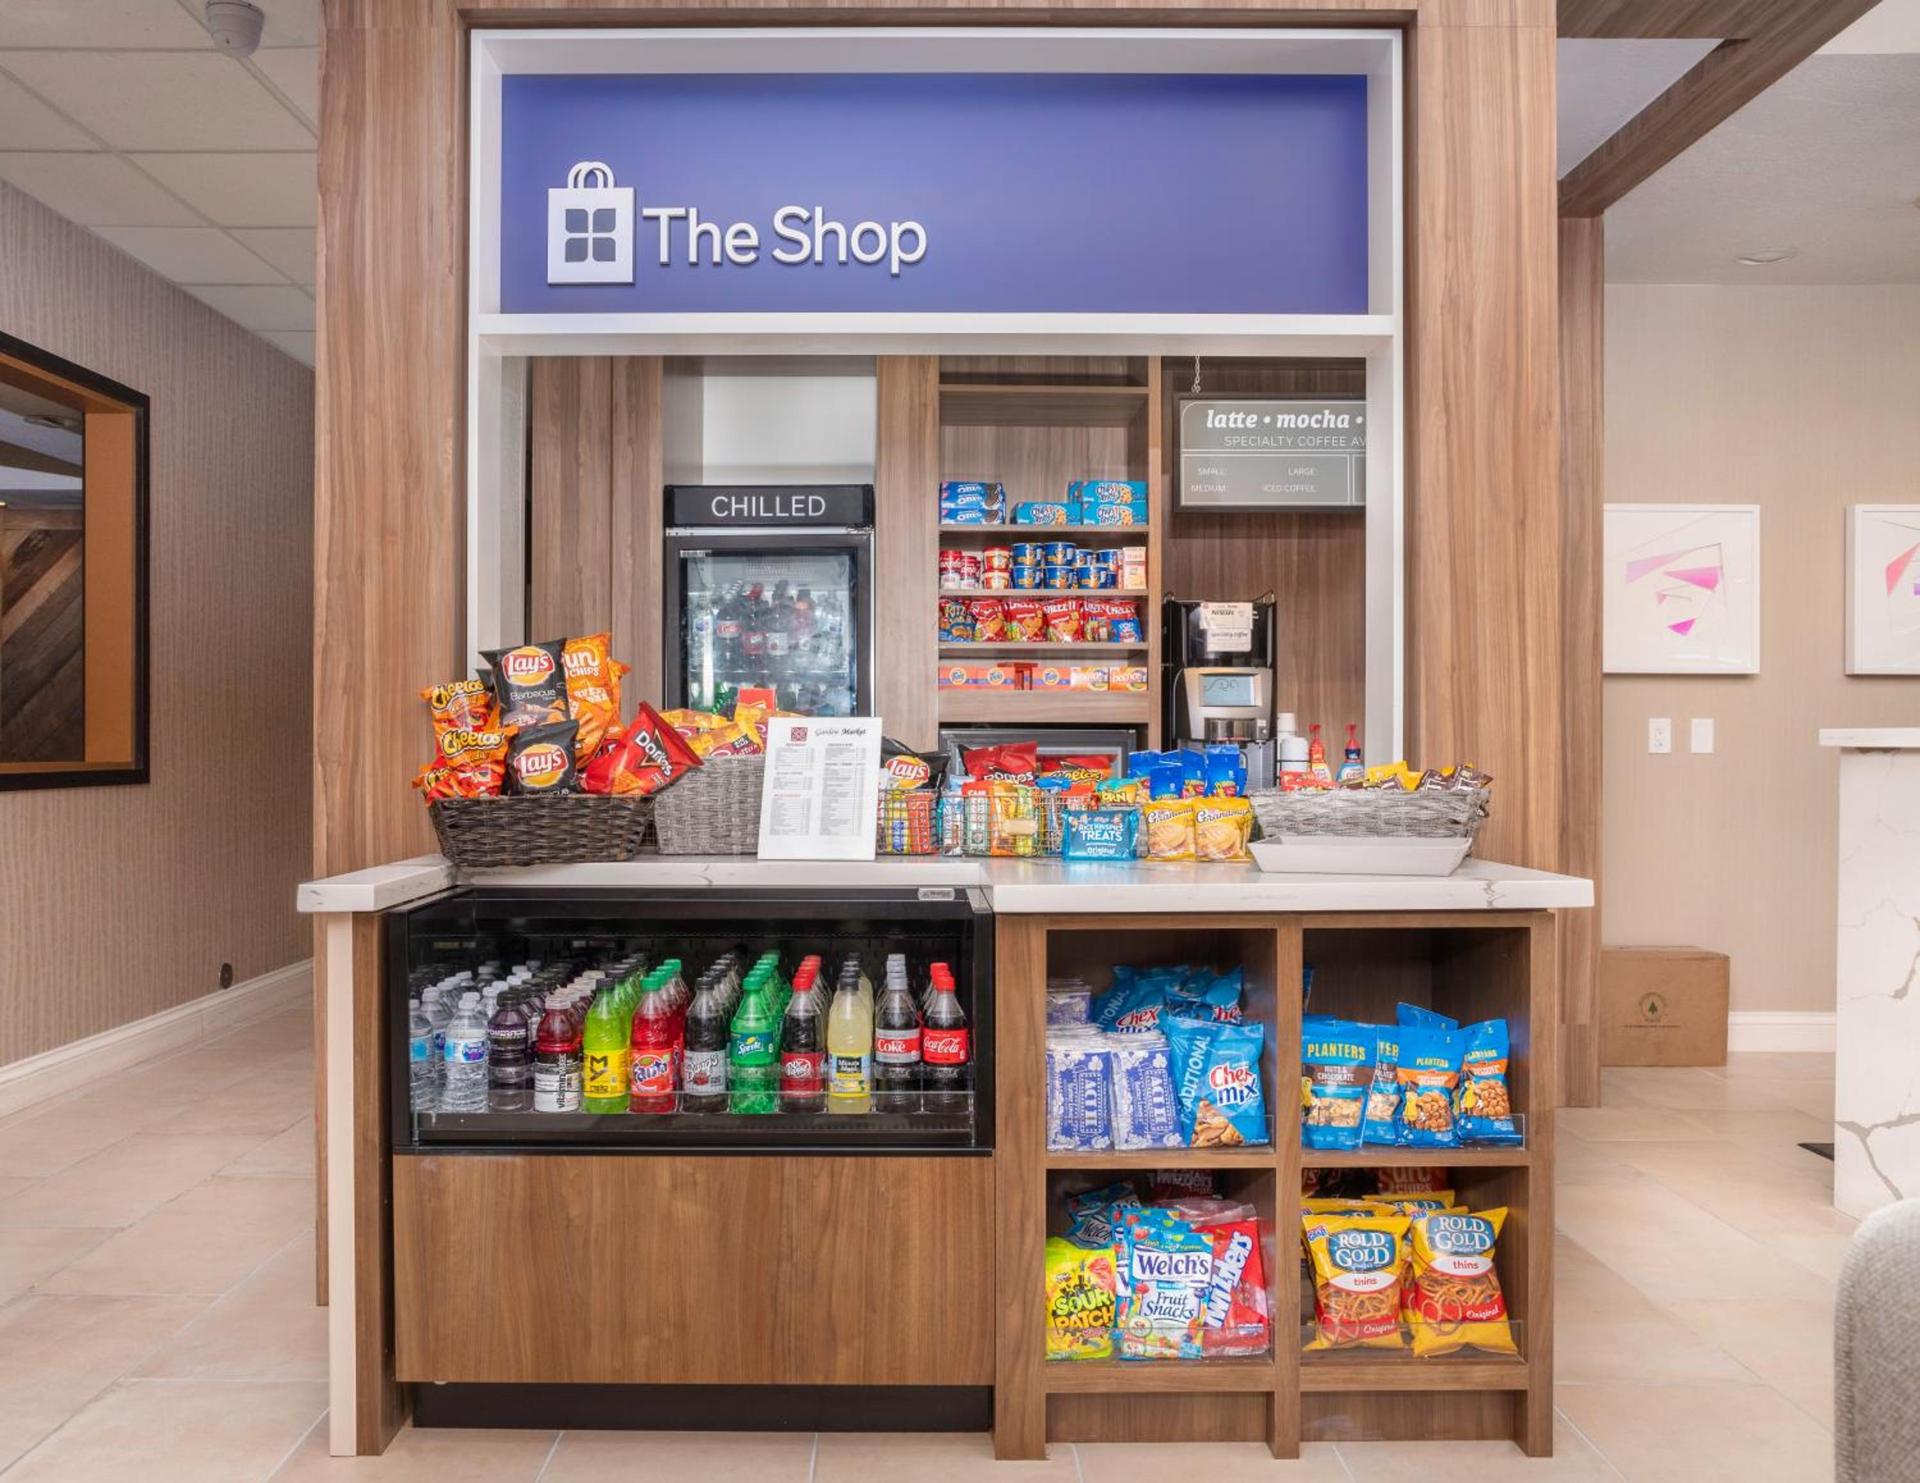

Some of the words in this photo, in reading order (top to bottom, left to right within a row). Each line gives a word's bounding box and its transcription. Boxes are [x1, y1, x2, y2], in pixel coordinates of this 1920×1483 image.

[642, 206, 760, 265] The
[771, 205, 928, 277] Shop
[1206, 409, 1258, 429] latte
[1276, 409, 1351, 429] mocha
[1223, 435, 1294, 447] SPECIALTY
[1297, 435, 1347, 447] COFFEE
[711, 495, 826, 517] CHILLED
[441, 730, 504, 758] Cheetos
[634, 730, 673, 777] Doritos
[1080, 829, 1123, 842] TREATS
[1116, 1008, 1161, 1027] Chex
[738, 1039, 764, 1056] Sprite
[876, 1039, 906, 1053] Coke
[1306, 1042, 1367, 1061] PLANTERS
[633, 1059, 668, 1082] Fanta
[1209, 1063, 1257, 1090] Chex
[1217, 1084, 1259, 1106] mix
[1437, 1216, 1486, 1233] ROLD
[1338, 1232, 1386, 1249] ROLD
[1434, 1232, 1491, 1251] GOLD
[1137, 1253, 1210, 1277] Welch's
[1335, 1248, 1390, 1268] GOLD
[1452, 1259, 1480, 1271] thins
[1353, 1276, 1378, 1287] thins
[1054, 1289, 1114, 1316] SOUR
[1155, 1291, 1189, 1307] Fruit
[1053, 1305, 1115, 1331] PATCH
[1143, 1301, 1196, 1320] Snacks
